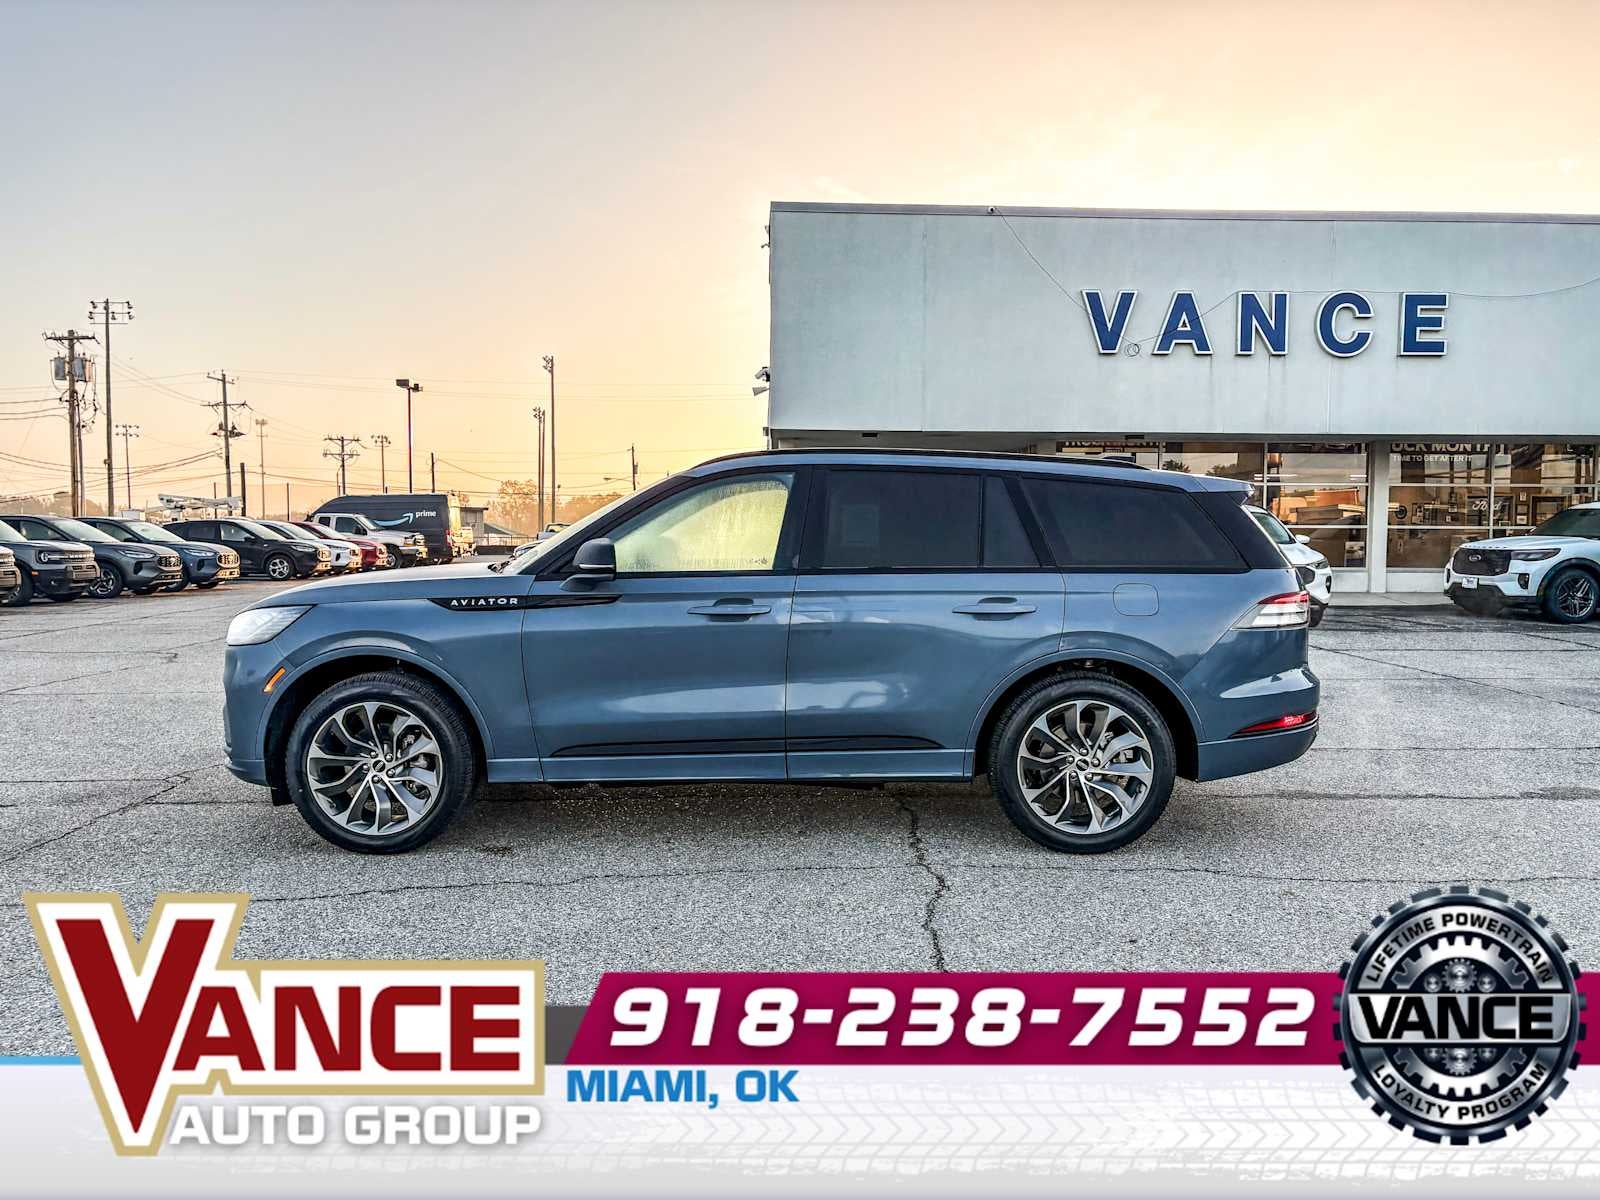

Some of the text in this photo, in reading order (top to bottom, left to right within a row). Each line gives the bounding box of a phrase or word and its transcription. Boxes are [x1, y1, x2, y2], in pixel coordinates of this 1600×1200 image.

[1080, 289, 1450, 358] VANCE
[1472, 500, 1503, 511] Fod
[415, 509, 437, 518] prime
[450, 598, 518, 606] AVIATOR
